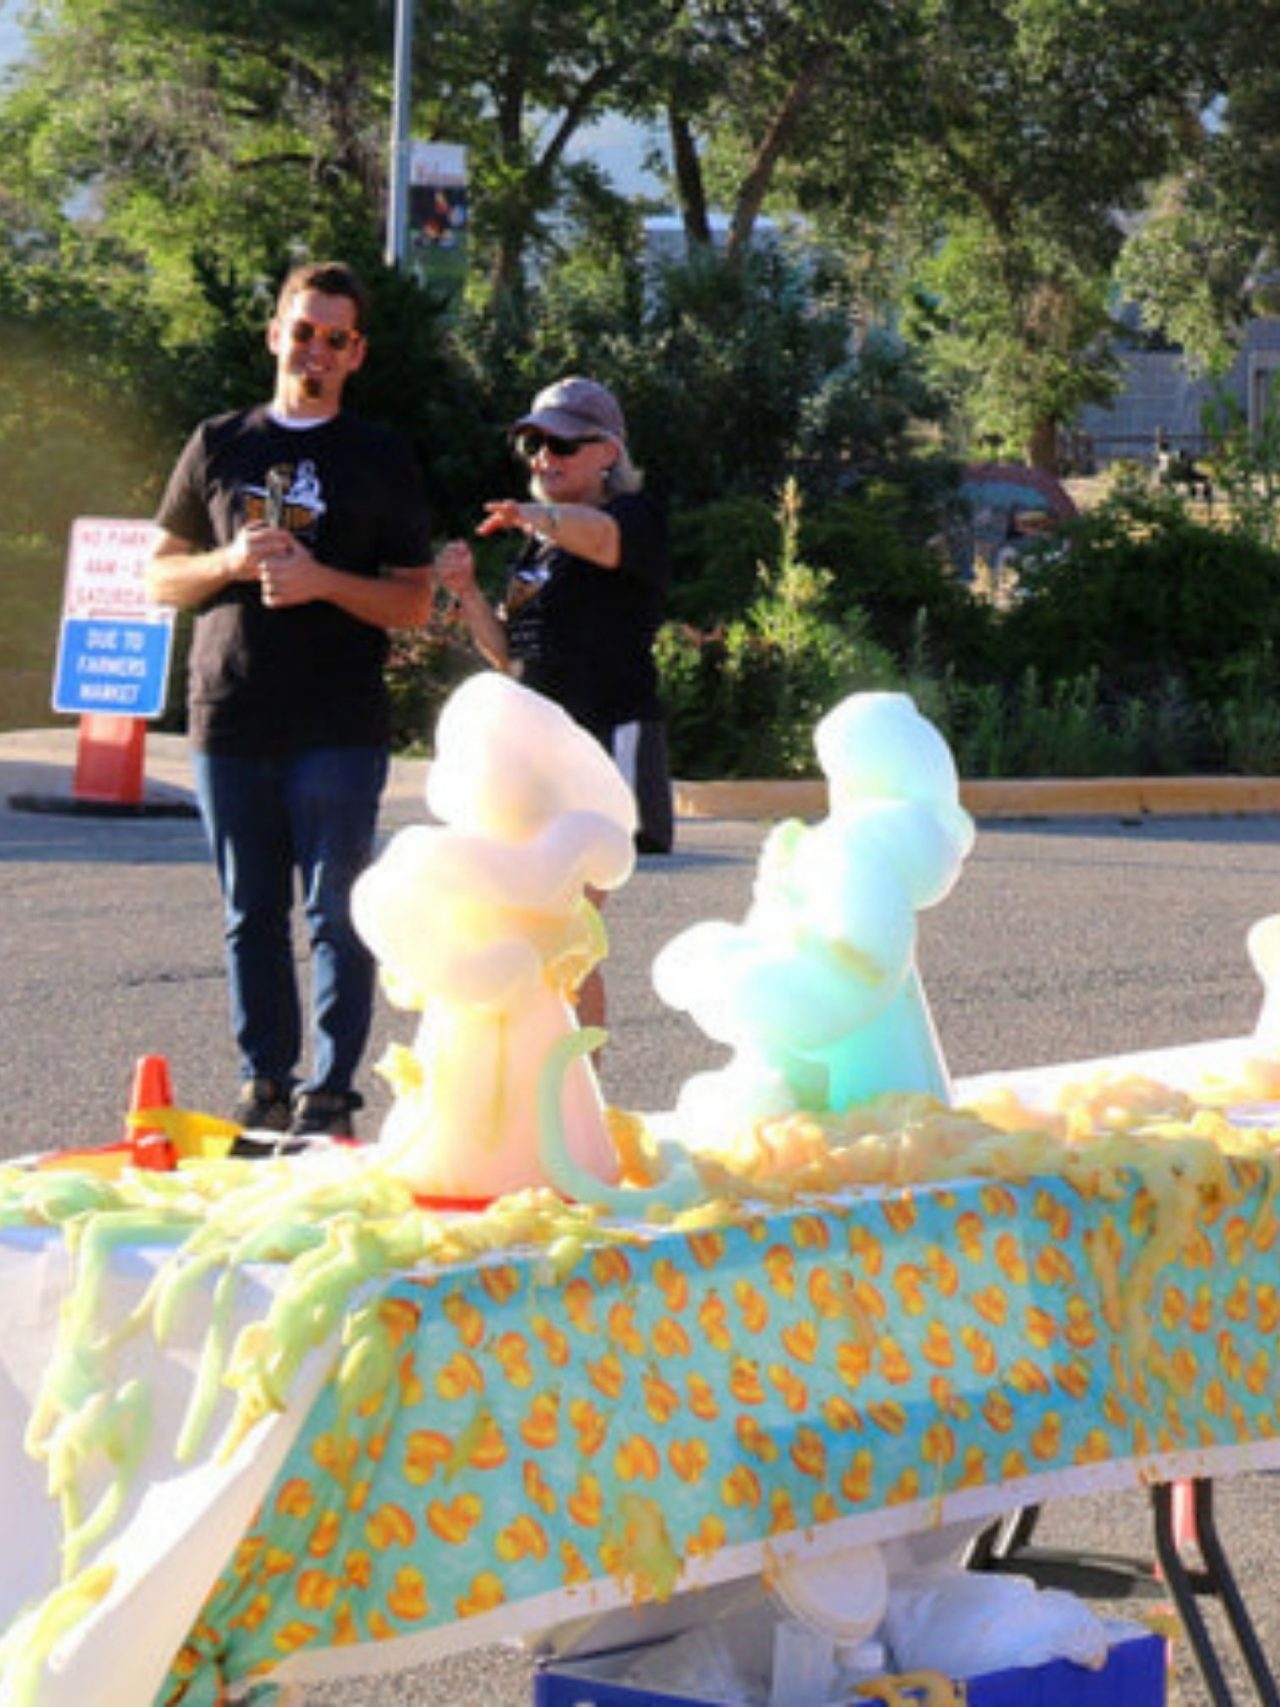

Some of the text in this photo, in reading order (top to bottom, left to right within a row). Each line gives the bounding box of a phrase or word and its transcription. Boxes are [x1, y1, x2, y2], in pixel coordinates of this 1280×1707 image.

[86, 628, 145, 653] DUE TO
[77, 655, 147, 677] FARMERS
[80, 683, 140, 704] MARKET
